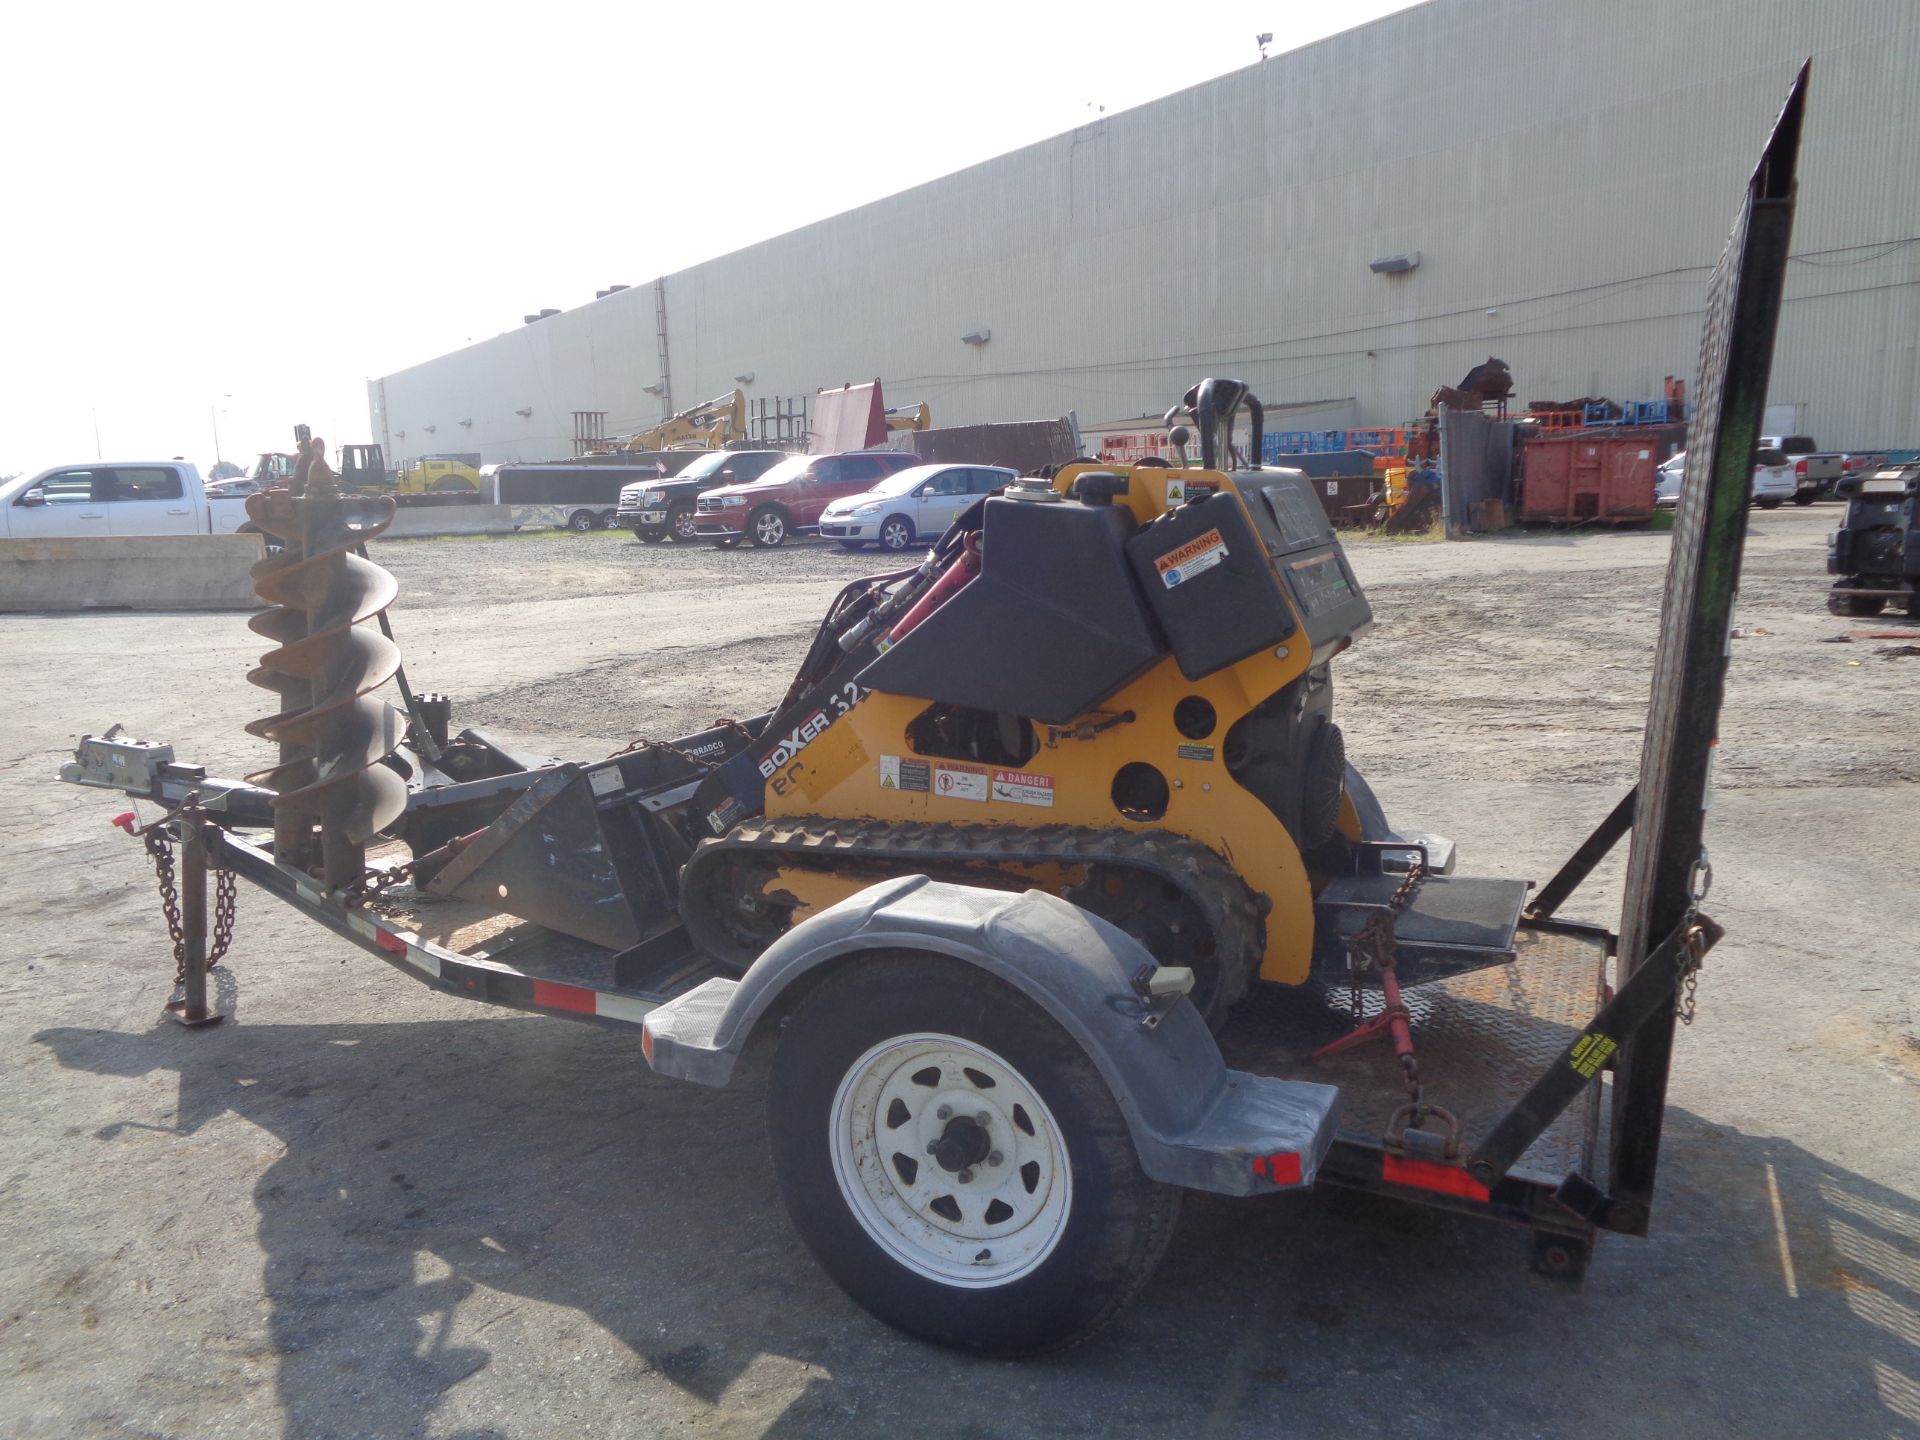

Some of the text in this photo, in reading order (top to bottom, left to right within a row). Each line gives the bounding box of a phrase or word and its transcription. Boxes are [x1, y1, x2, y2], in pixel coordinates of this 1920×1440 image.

[694, 416, 705, 426] CAT
[1615, 450, 1641, 479] 17
[1167, 532, 1220, 565] WARNING
[758, 712, 831, 779] BOXER
[830, 682, 873, 717] 32
[693, 740, 724, 756] BRADCO
[1008, 773, 1049, 787] DANGER!
